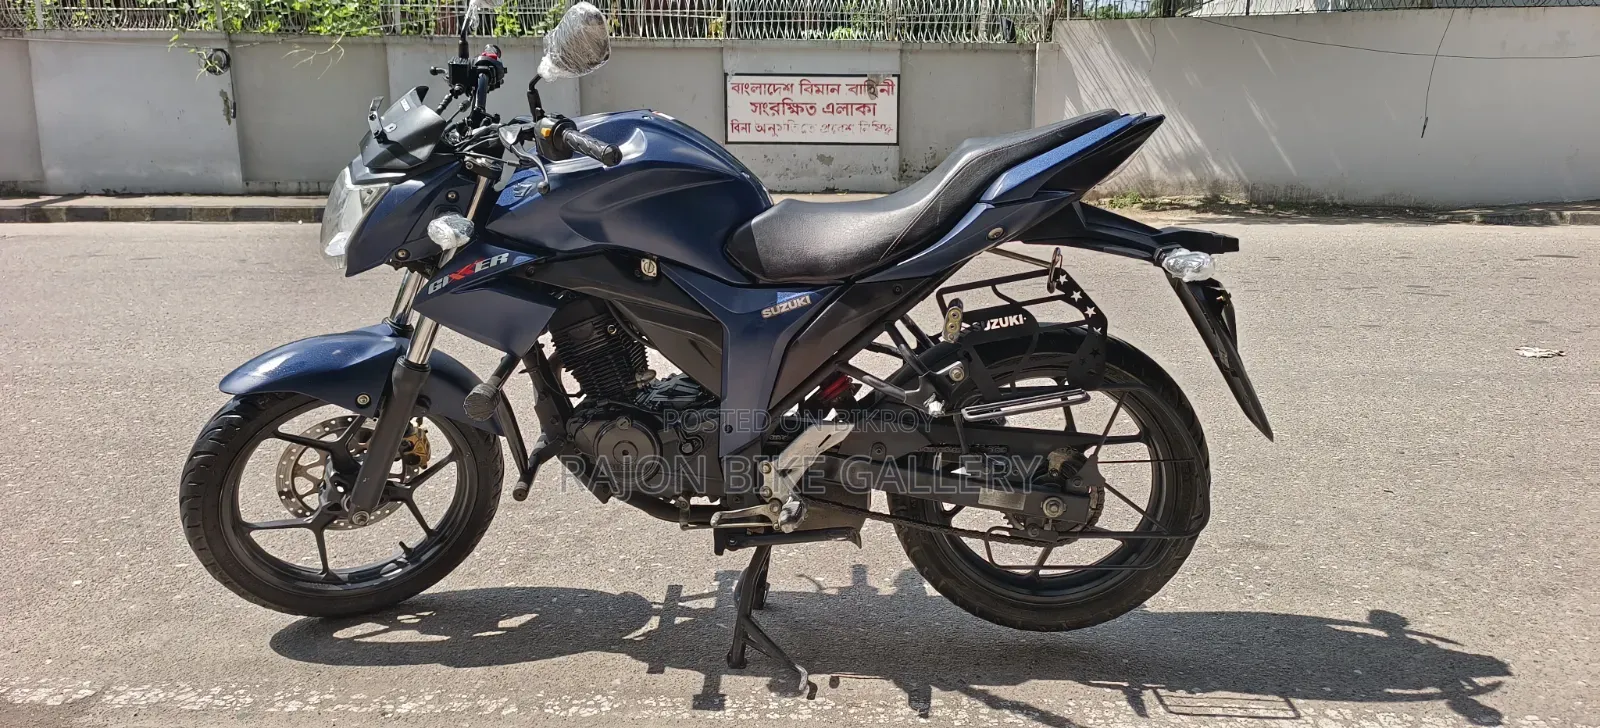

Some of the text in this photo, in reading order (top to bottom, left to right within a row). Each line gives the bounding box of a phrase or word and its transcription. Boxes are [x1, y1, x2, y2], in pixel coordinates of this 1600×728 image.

[731, 82, 794, 97] বাংলাদেশ
[799, 79, 841, 96] বিমান
[750, 97, 877, 117] সংরক্ষিত এলাকা
[730, 119, 751, 134] বিনা
[761, 295, 812, 318] SUZUKI
[972, 314, 1024, 332] SUZUKI
